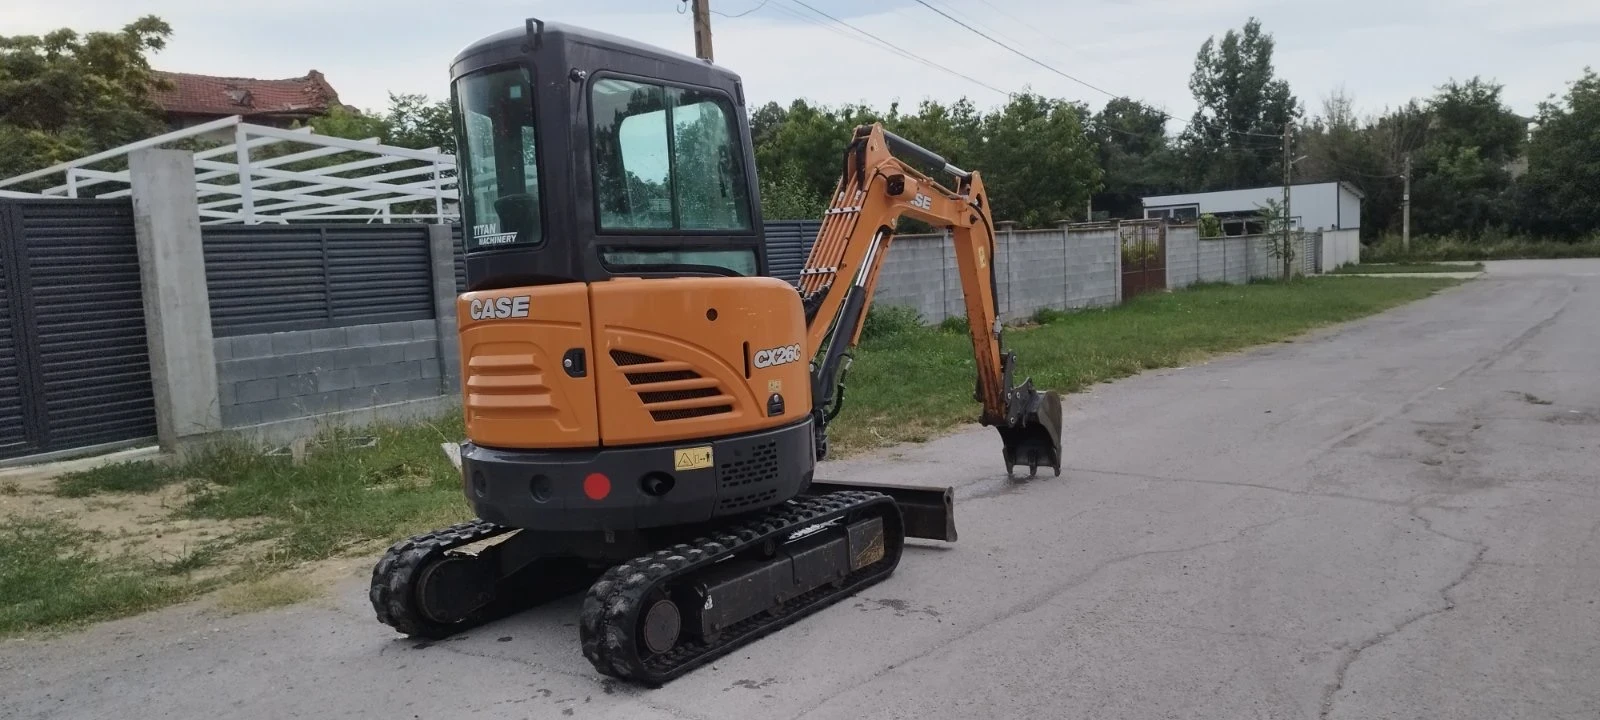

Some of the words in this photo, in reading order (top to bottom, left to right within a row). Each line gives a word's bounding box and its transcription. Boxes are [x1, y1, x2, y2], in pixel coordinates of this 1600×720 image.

[473, 223, 496, 236] TITAN
[479, 234, 517, 246] MACHINERY
[470, 295, 531, 320] CASE
[753, 342, 801, 369] CX26C
